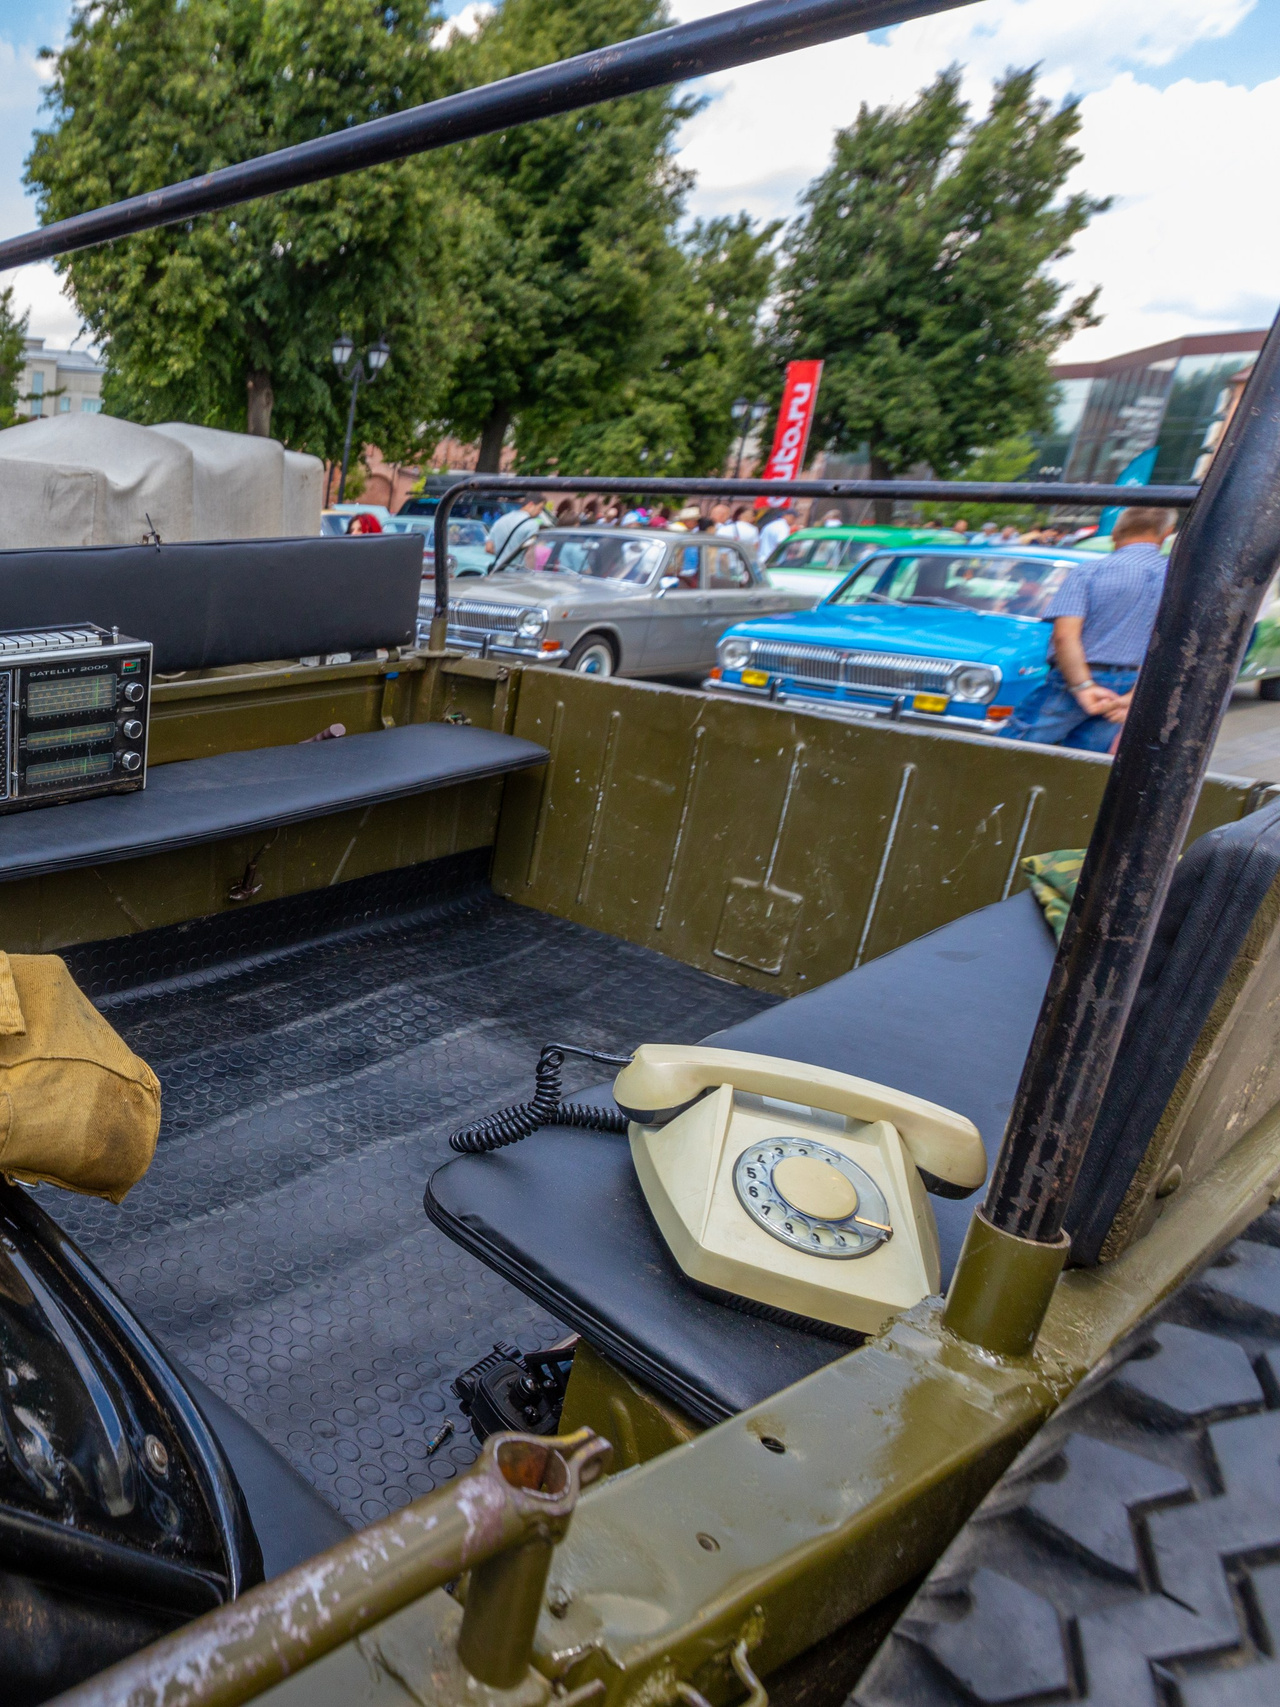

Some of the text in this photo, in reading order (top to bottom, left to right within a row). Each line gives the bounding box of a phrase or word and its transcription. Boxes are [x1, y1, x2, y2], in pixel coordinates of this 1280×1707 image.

[29, 664, 109, 678] SATELLIT 2000
[746, 1167, 757, 1179] 5
[748, 1186, 759, 1198] 6
[761, 1205, 771, 1216] 7
